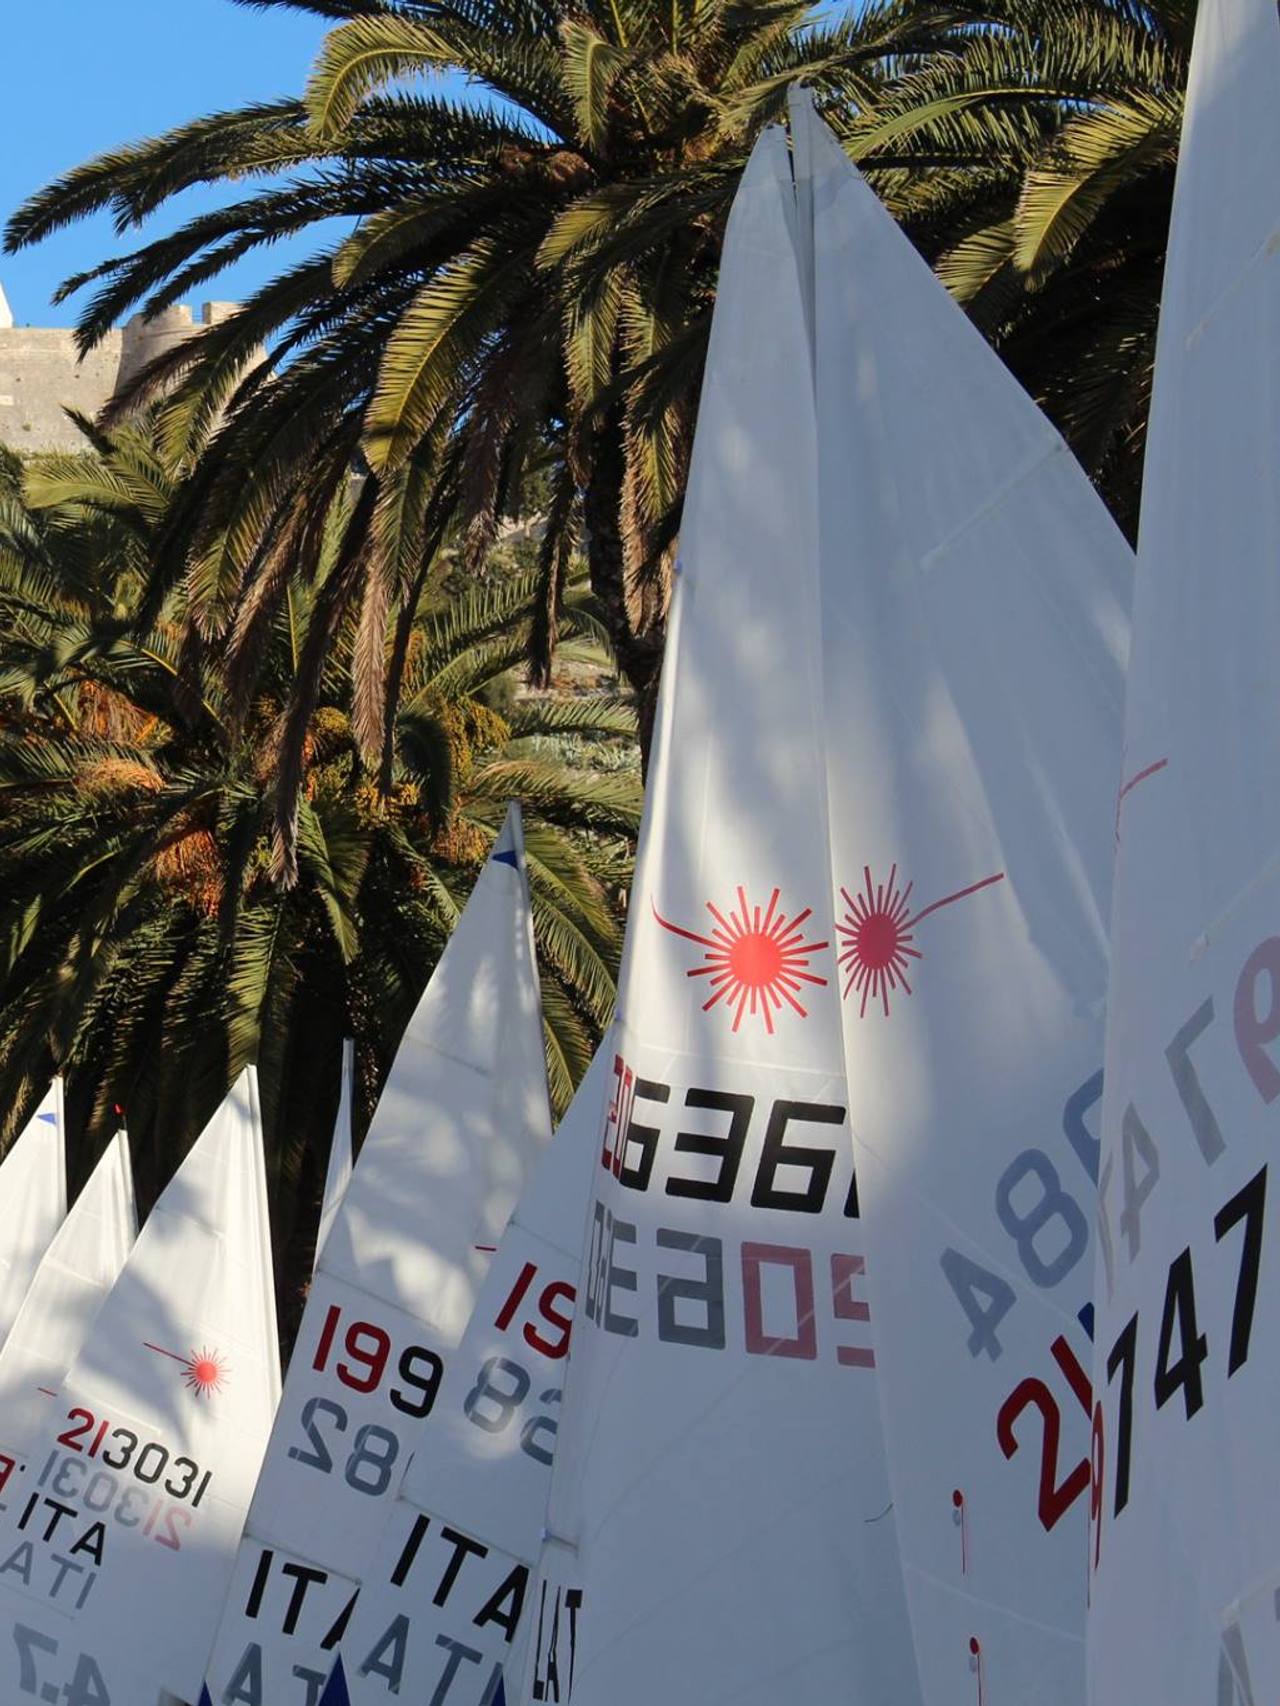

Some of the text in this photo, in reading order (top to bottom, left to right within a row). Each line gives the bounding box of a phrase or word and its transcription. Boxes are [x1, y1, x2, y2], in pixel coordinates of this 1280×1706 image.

[601, 1053, 861, 1220] 20636
[312, 1304, 444, 1420] 199
[996, 1302, 1095, 1532] 21
[56, 1406, 213, 1508] 213031
[18, 1491, 107, 1567] ITA
[389, 1513, 532, 1645] ITA
